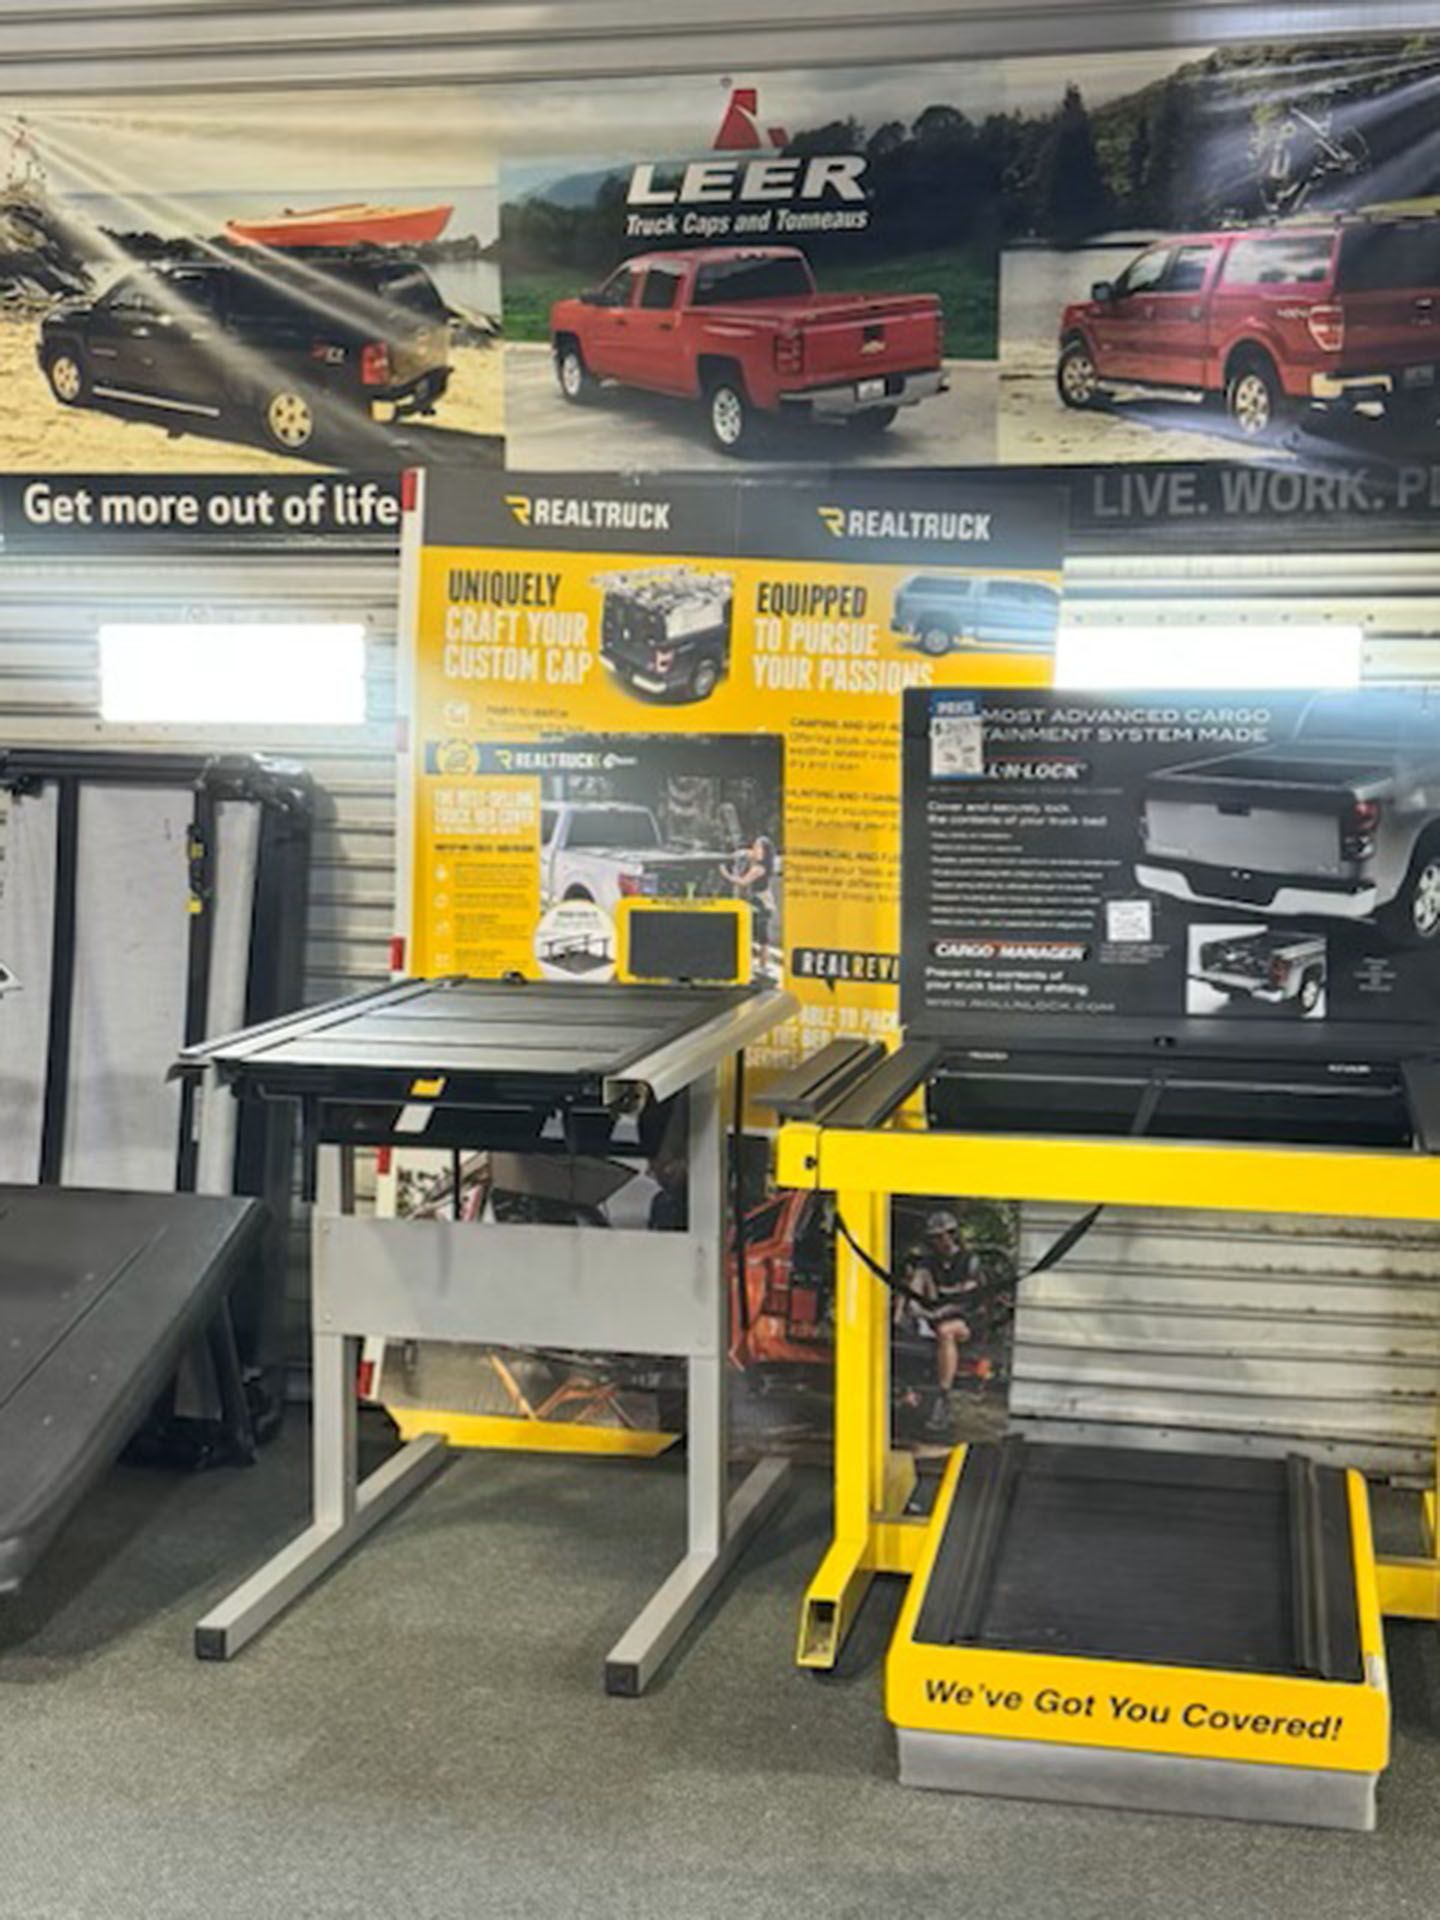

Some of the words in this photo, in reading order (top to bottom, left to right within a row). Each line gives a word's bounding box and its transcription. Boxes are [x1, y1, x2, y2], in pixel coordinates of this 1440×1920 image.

[626, 155, 868, 204] LEER
[627, 214, 677, 236] Truck
[682, 211, 730, 237] Caps
[733, 209, 770, 232] and
[776, 208, 868, 231] Tonneaus
[23, 482, 93, 523] Get
[101, 494, 199, 524] more
[206, 489, 275, 524] out
[282, 483, 326, 524] of
[333, 484, 399, 524] life
[1093, 472, 1208, 517] LIVE.
[1219, 467, 1385, 515] WORK.
[533, 498, 670, 530] REALTRUCK
[849, 510, 990, 541] REALTRUCK
[448, 569, 562, 608] UNIQUELY
[756, 582, 868, 618] EQUIPPED
[445, 606, 519, 643] CRAFT
[526, 611, 589, 648] YOUR
[754, 617, 782, 651] TO
[788, 620, 880, 656] PURSUE
[444, 643, 539, 682] CUSTOM
[545, 648, 594, 685] CAP
[752, 653, 812, 691] YOUR
[818, 656, 934, 696] PASSIONS
[981, 708, 1045, 724] MOST
[1051, 708, 1180, 724] ADVANCED
[1184, 707, 1271, 725] CARGO
[1097, 727, 1194, 744] SYSTEM
[1198, 727, 1269, 743] MADE
[924, 1680, 1021, 1711] We've
[1033, 1690, 1095, 1718] Got
[1107, 1697, 1169, 1725] You
[1181, 1703, 1343, 1742] Covered!
